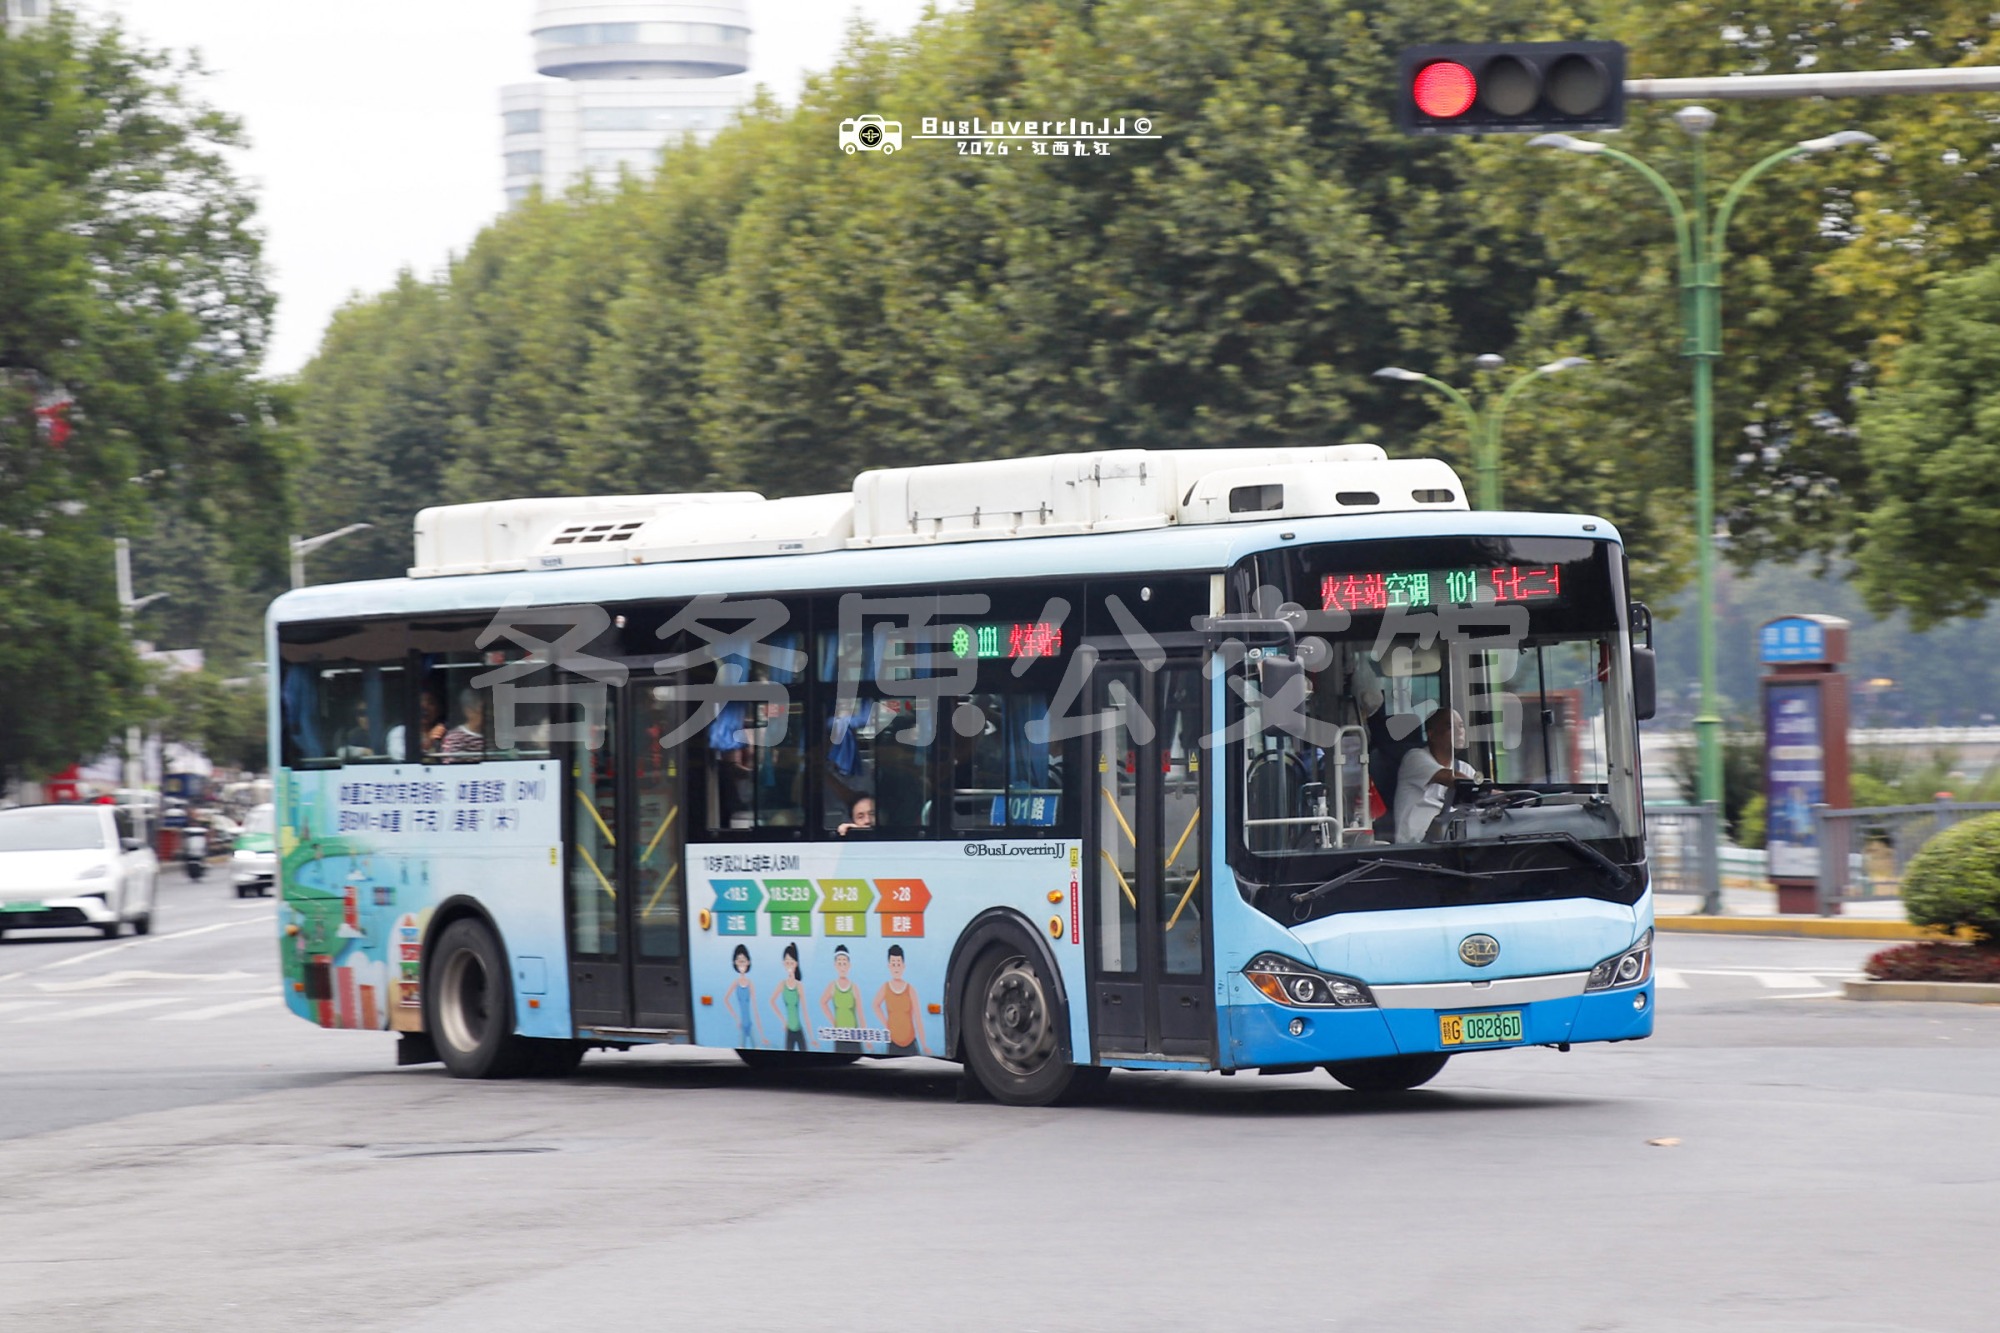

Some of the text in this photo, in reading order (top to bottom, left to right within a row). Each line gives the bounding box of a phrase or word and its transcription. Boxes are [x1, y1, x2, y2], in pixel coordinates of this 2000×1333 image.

[1321, 574, 1387, 612] 火车站
[1386, 572, 1431, 608] 空调
[1446, 570, 1478, 604] 101
[977, 626, 999, 657] 101
[1008, 796, 1046, 820] 01路
[832, 886, 859, 902] 24-28
[1467, 1016, 1521, 1039] 08286D
